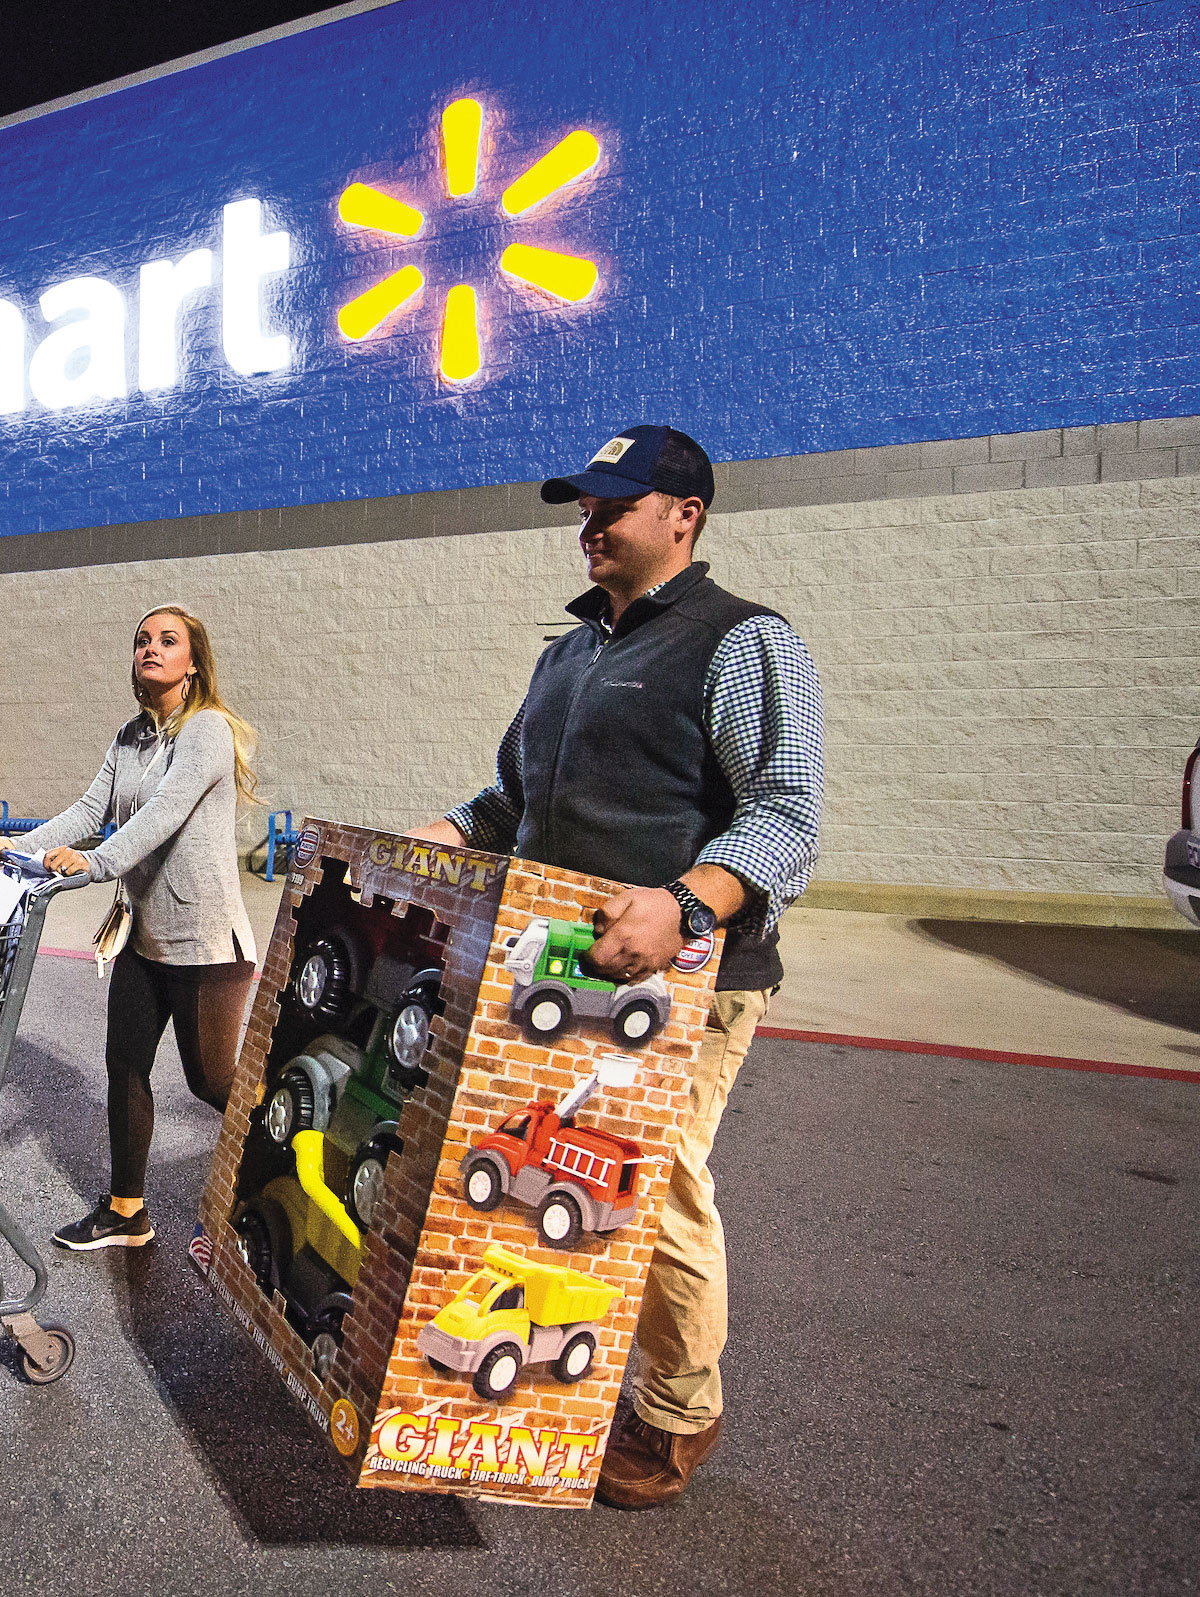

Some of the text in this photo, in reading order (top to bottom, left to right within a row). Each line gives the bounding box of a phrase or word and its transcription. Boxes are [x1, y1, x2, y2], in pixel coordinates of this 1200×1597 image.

[369, 838, 498, 892] GIANT
[232, 1298, 250, 1328] TRUCK
[252, 1328, 266, 1350] FIRE
[264, 1343, 285, 1373] TRUCK
[287, 1373, 307, 1402] DUMP
[307, 1396, 330, 1432] TRUCK
[335, 1409, 355, 1439] 2+
[377, 1411, 600, 1479] GIANT
[369, 1456, 590, 1490] RECYCLING TRUCK FIRE TRUCK DUMP TRUCK
